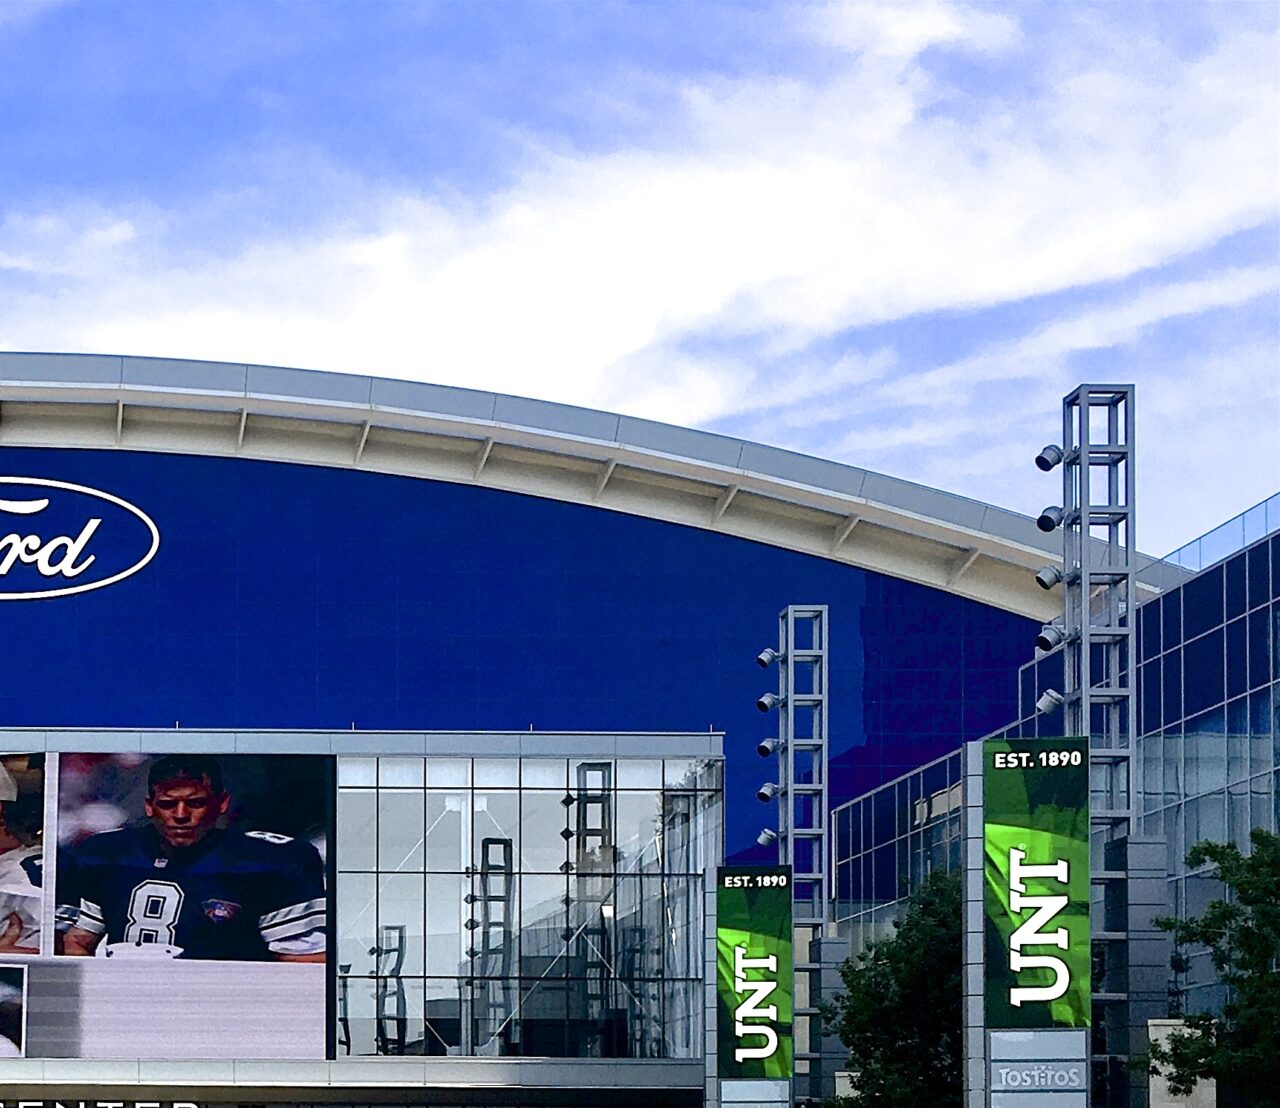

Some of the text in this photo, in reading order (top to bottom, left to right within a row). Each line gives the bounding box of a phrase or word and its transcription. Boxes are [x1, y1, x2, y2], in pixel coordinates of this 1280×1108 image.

[995, 750, 1082, 768] EST. 1890
[124, 879, 185, 944] 8
[724, 875, 787, 888] EST. 1890
[1009, 847, 1070, 1007] UNT
[734, 945, 778, 1063] UNT
